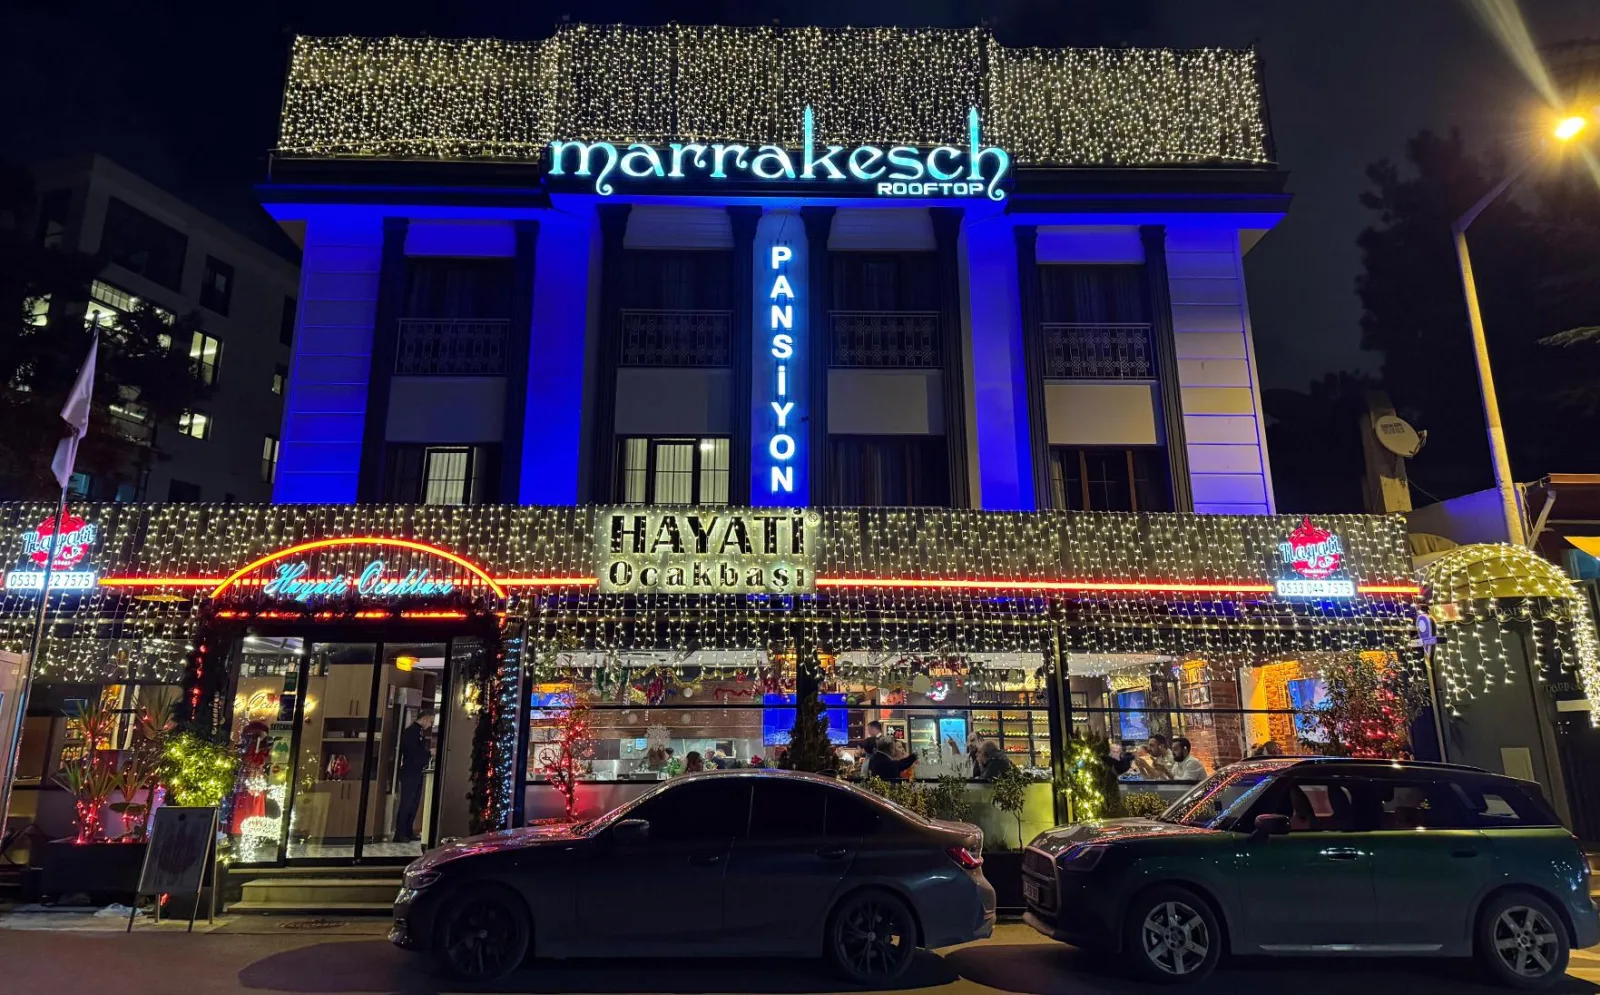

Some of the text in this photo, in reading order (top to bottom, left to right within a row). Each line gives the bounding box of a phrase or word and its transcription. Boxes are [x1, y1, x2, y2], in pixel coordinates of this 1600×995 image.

[548, 103, 1010, 201] marrakesch
[877, 183, 984, 196] ROOFTOP
[10, 574, 37, 587] 0533
[64, 574, 91, 587] 7575
[609, 561, 805, 593] Ocakbaşı
